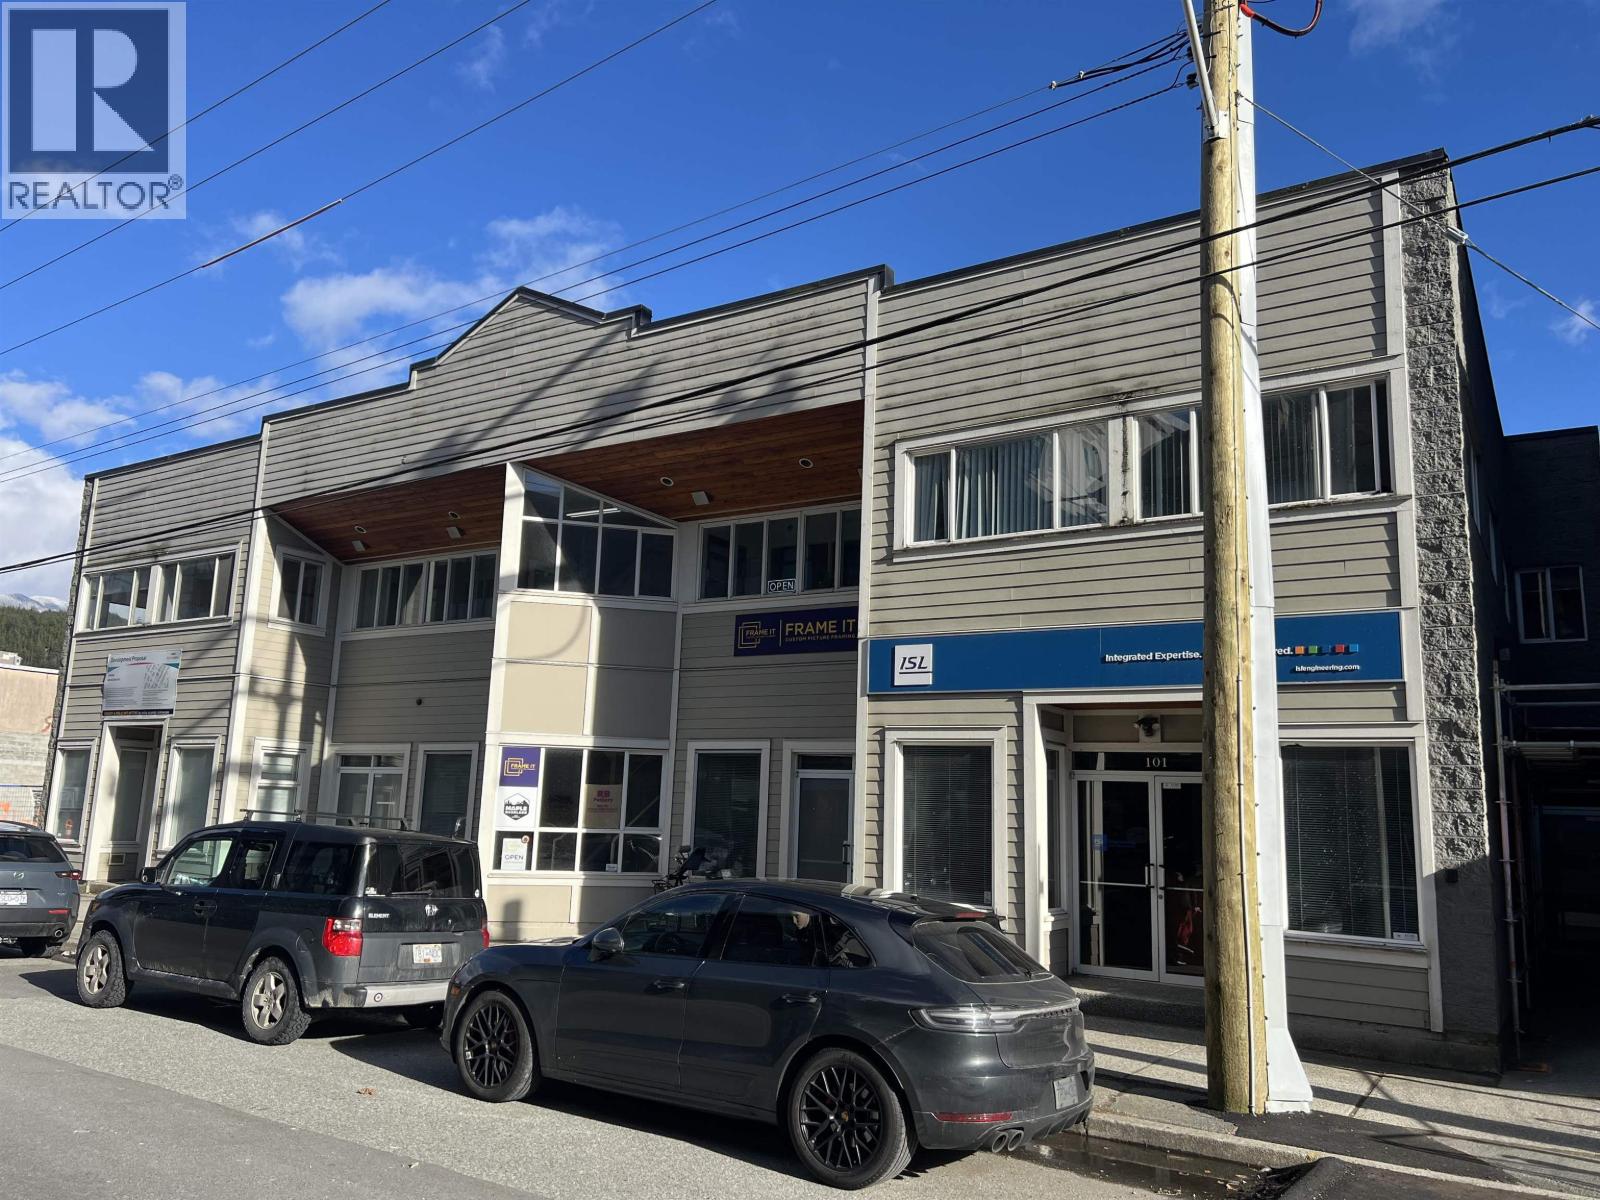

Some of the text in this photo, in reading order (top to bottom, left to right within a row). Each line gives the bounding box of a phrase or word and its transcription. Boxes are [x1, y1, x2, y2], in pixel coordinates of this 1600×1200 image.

[769, 581, 794, 591] OPEN
[745, 628, 769, 636] FRAME
[785, 619, 856, 636] FRAME IT
[1105, 650, 1203, 663] Integrated Expertise.
[900, 655, 928, 670] ISL
[1295, 664, 1360, 673] islengineering.com
[1146, 757, 1167, 767] 101
